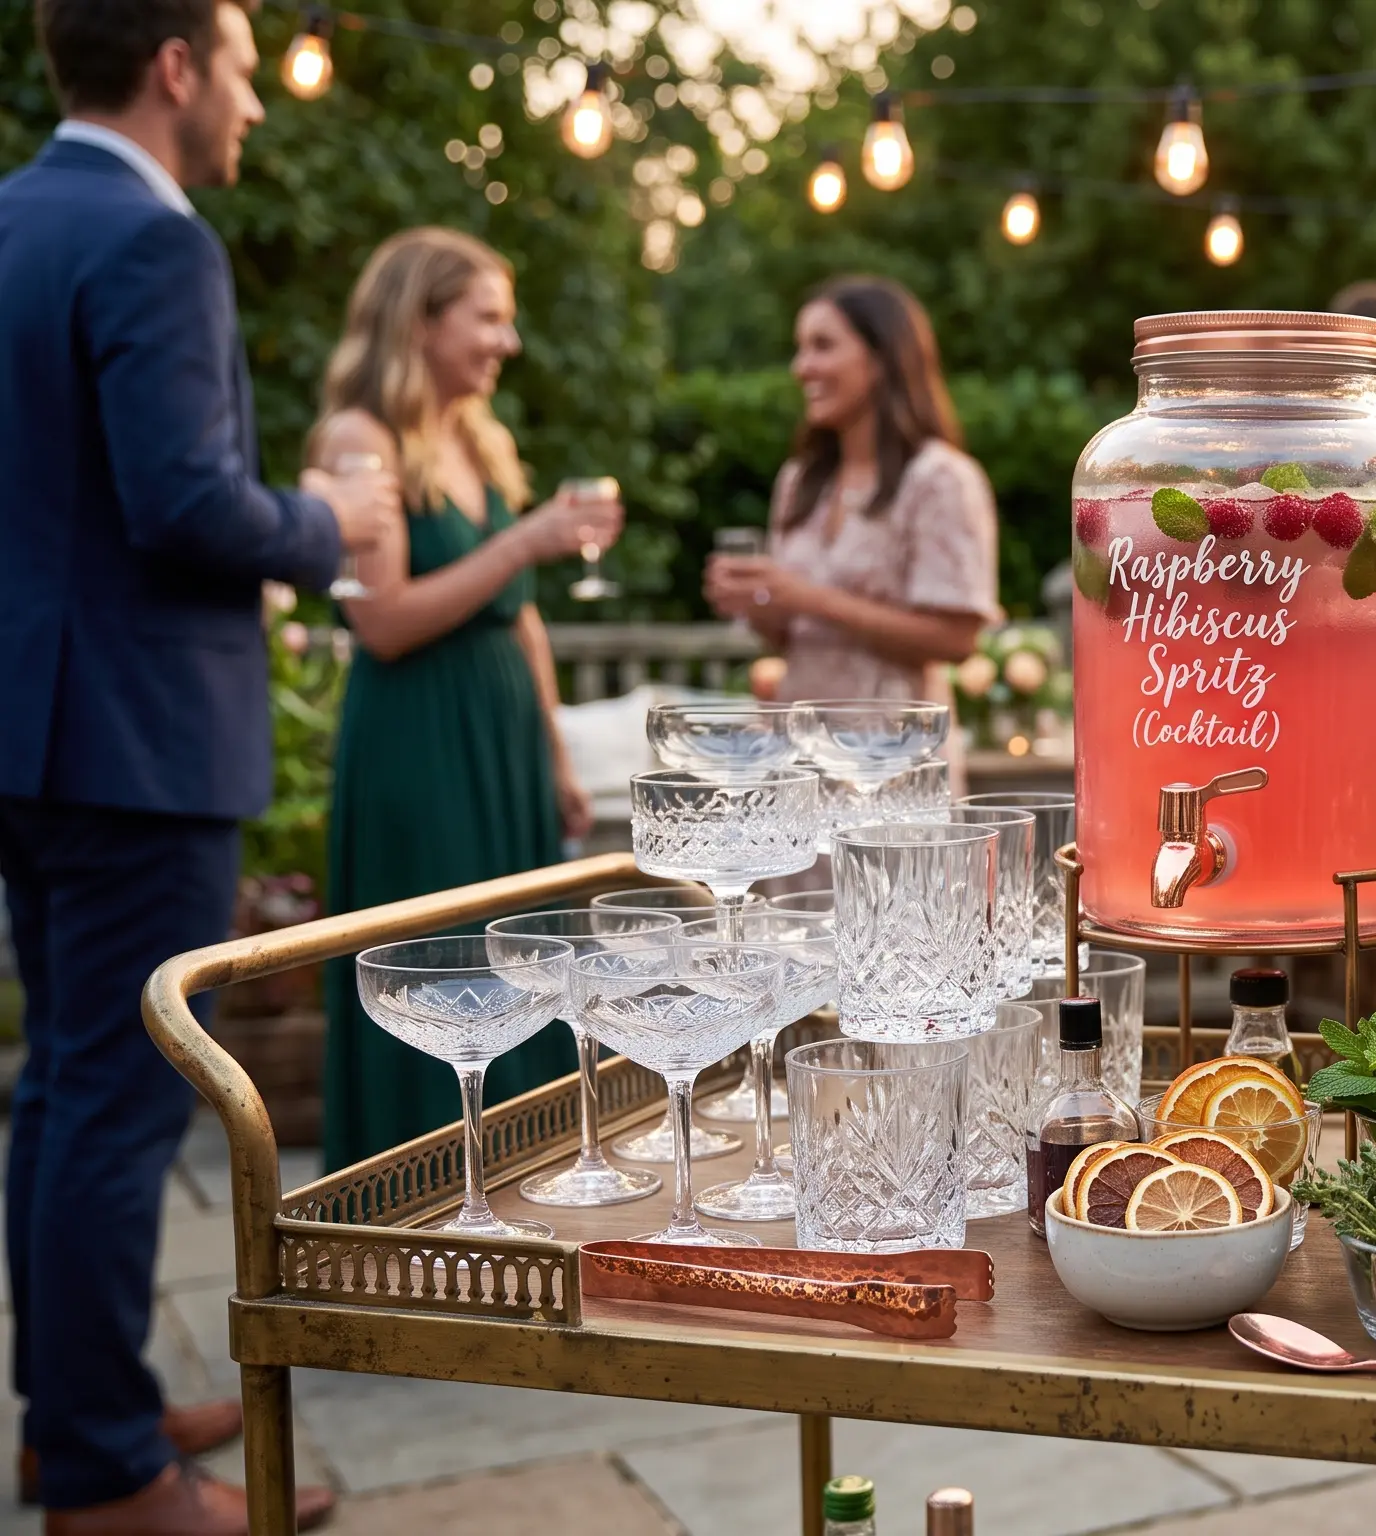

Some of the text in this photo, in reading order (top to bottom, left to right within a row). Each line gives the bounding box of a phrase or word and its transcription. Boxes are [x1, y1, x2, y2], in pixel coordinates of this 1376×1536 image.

[1107, 534, 1311, 604] Raspberry
[1122, 592, 1298, 646] Hibiscus
[1140, 643, 1276, 709] Spritz
[1132, 707, 1281, 753] (Cocktail)
